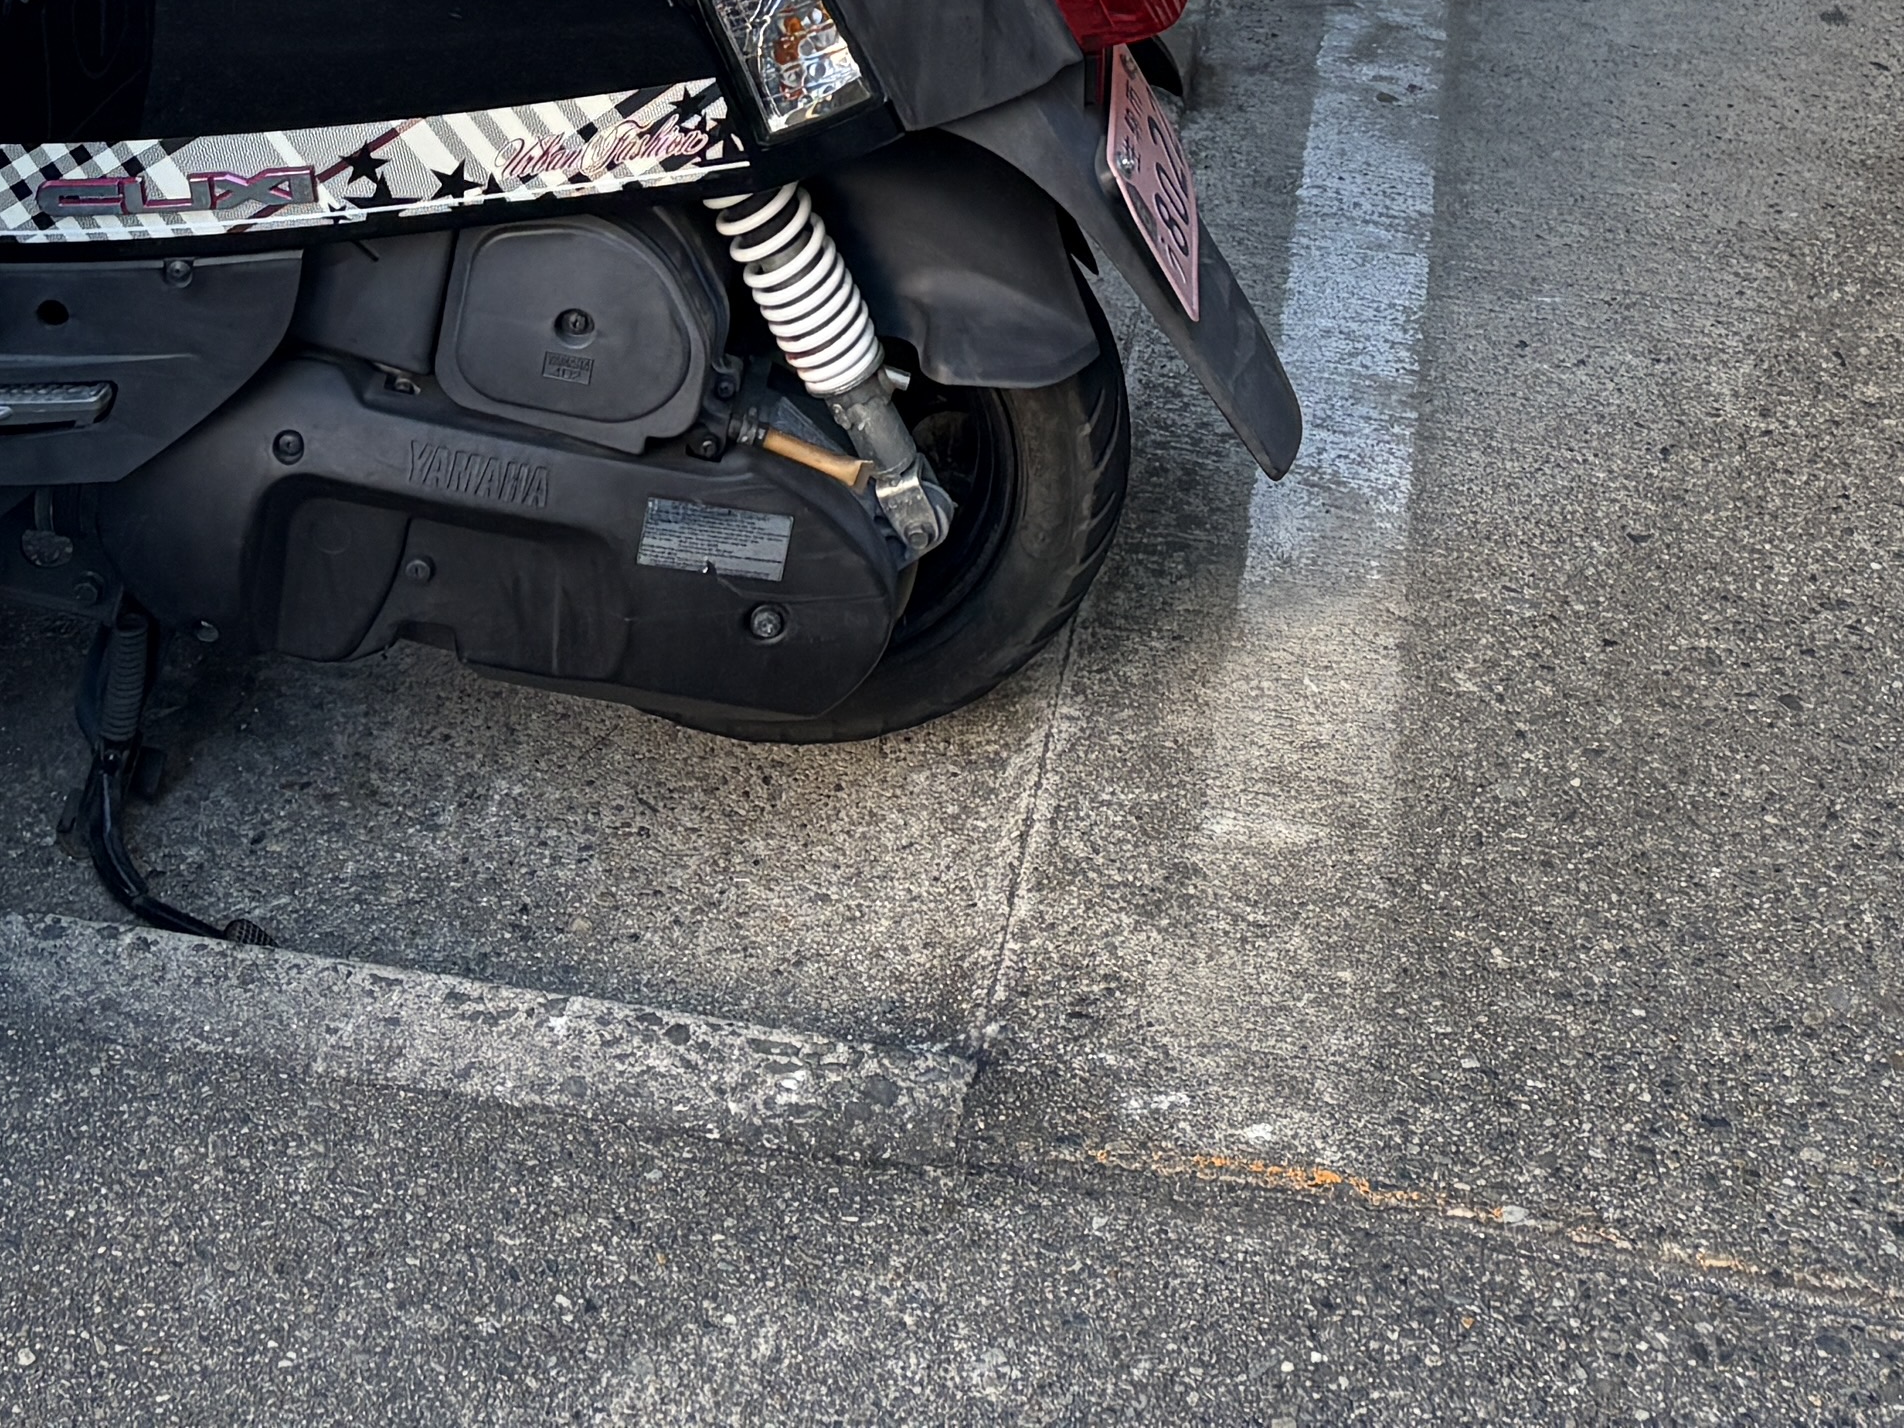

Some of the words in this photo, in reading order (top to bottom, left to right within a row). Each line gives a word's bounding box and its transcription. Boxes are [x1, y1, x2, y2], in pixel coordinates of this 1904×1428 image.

[497, 132, 588, 180] Urban
[585, 110, 710, 174] Fashion
[35, 164, 318, 215] CUXI
[407, 439, 550, 510] YAMAHA
